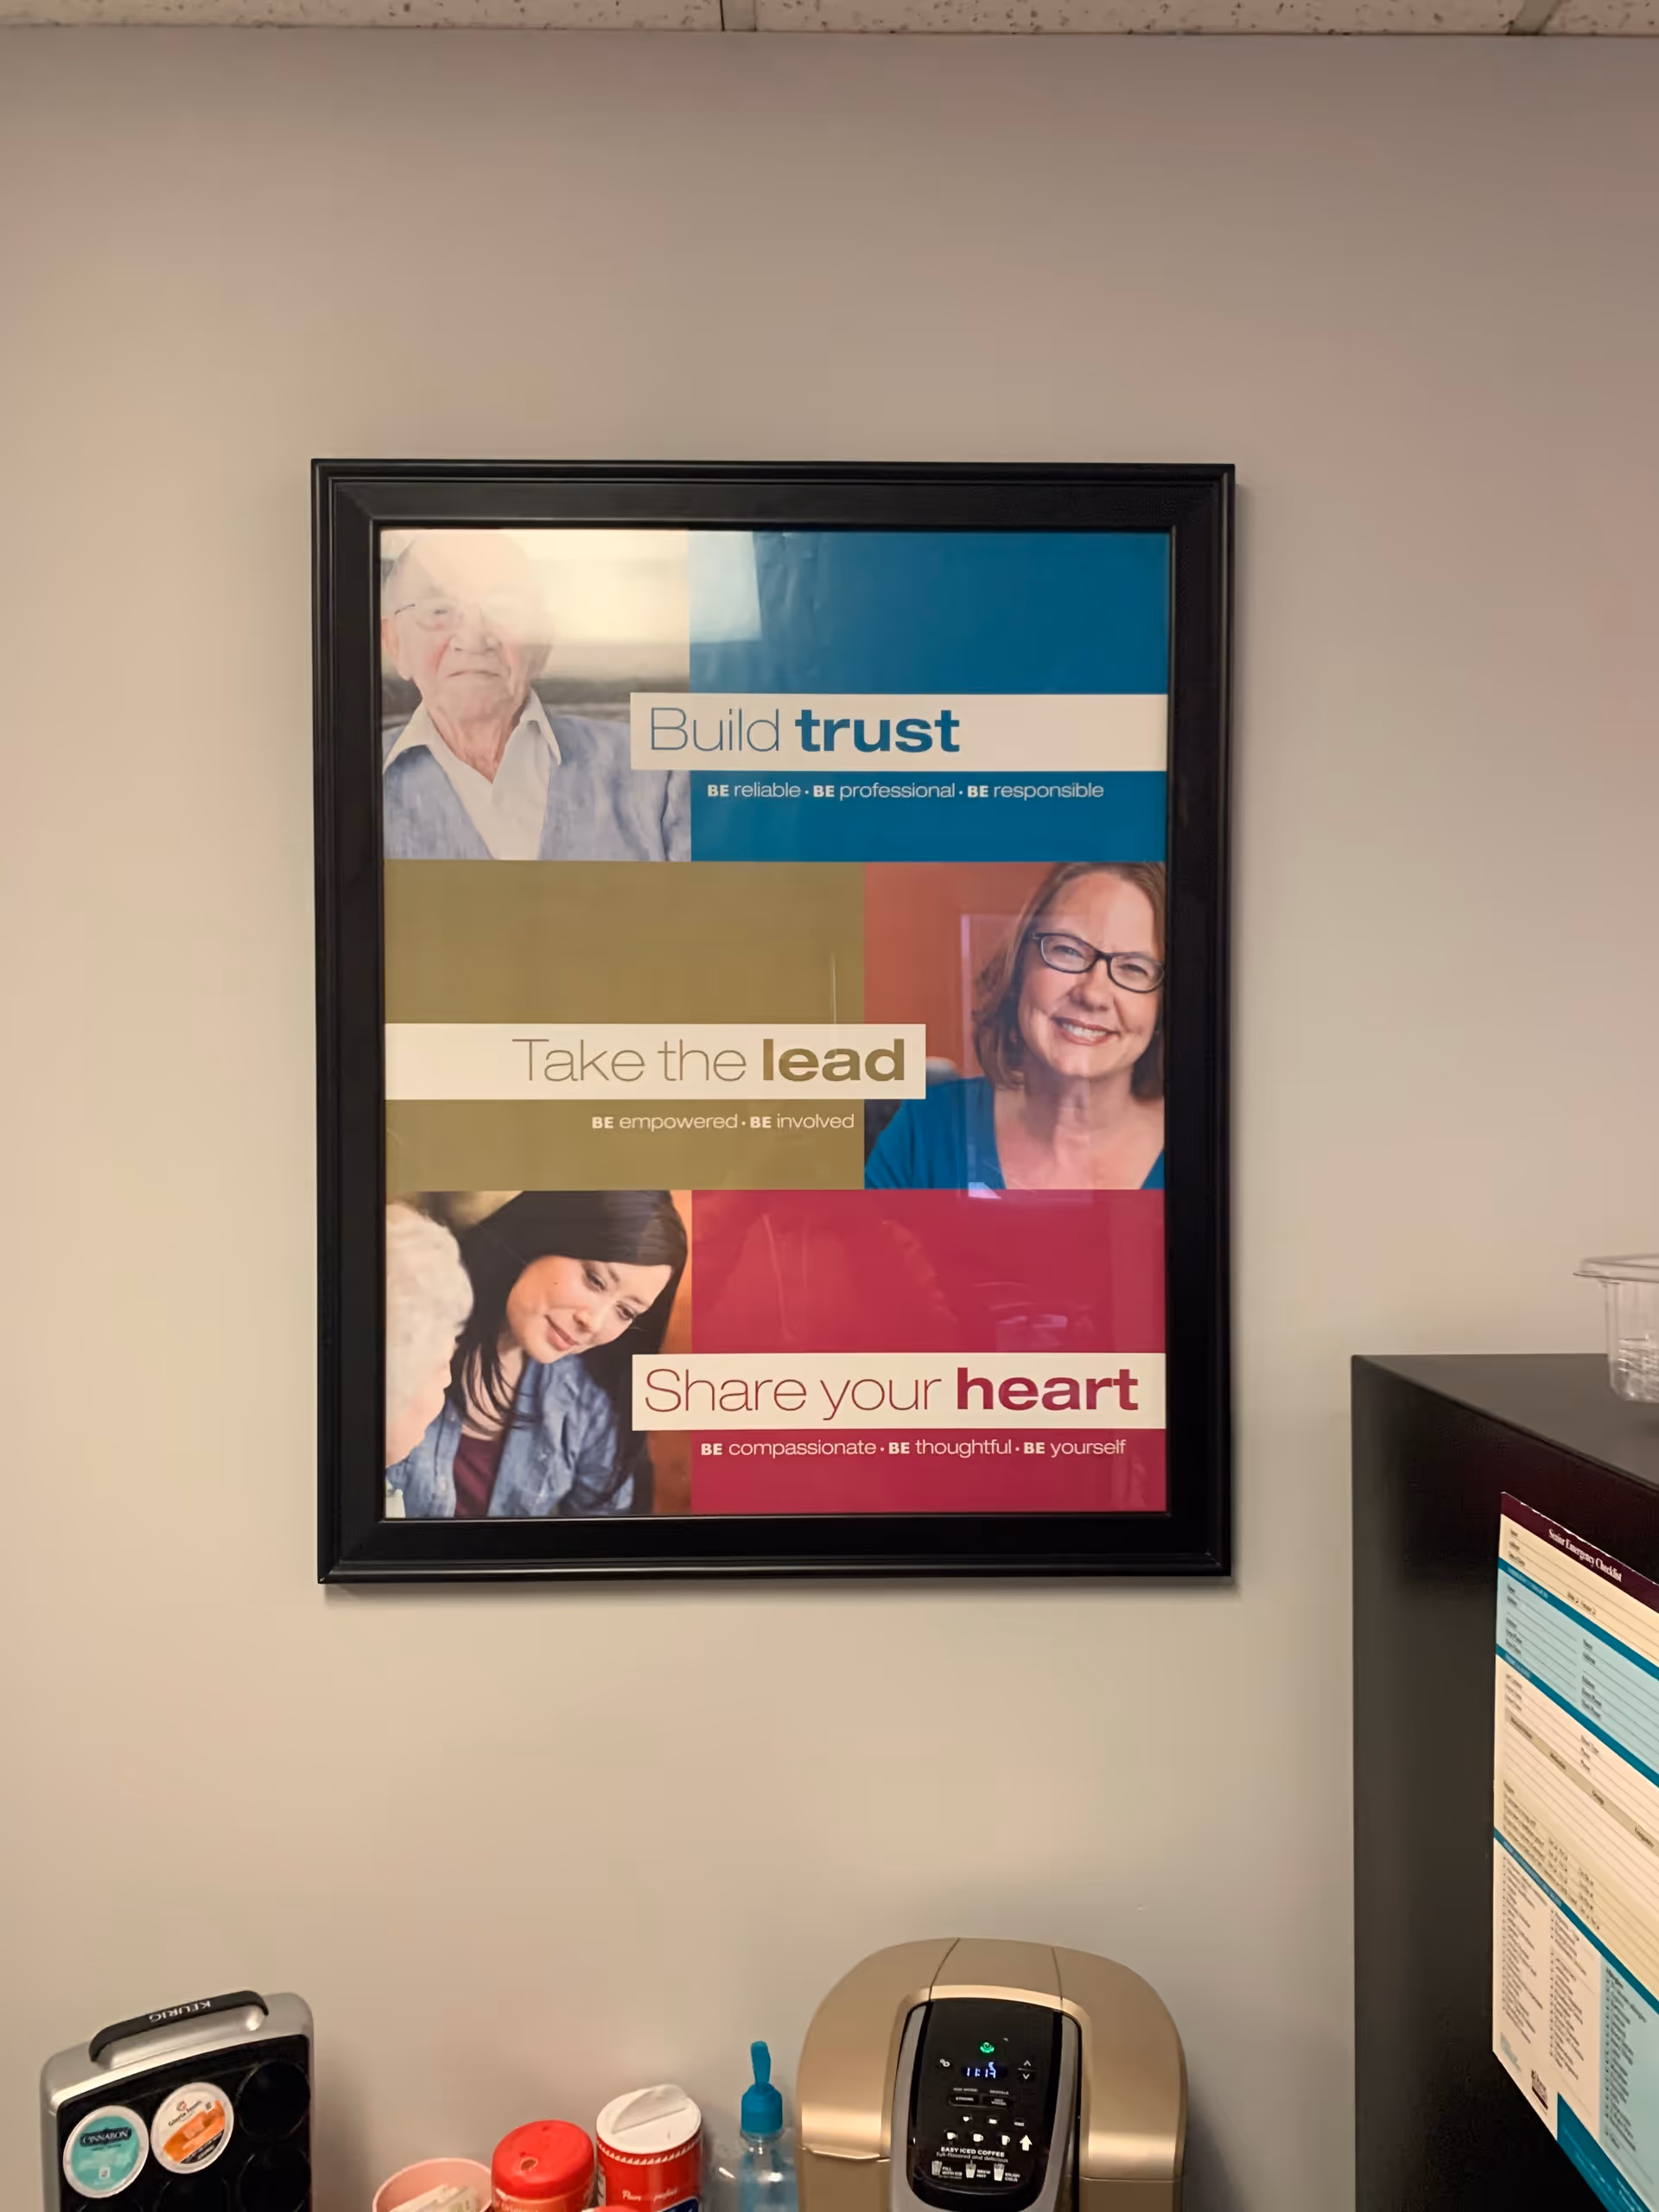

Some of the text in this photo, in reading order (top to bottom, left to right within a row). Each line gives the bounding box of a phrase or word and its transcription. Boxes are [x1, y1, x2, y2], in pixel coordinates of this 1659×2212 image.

[650, 707, 961, 753] Build trust
[707, 782, 1105, 801] BE reliable BE professional BE responsible
[512, 1038, 906, 1083] Take the lead
[592, 1113, 855, 1132] BE empowered BE involved
[645, 1367, 1139, 1421] Share your heart
[701, 1438, 1128, 1459] BE compassionate BE thoughtful BE yourself
[1548, 1528, 1622, 1582] Senior Emergency Checklist
[149, 2000, 211, 2022] KEURIG
[82, 2129, 130, 2145] CINNABON
